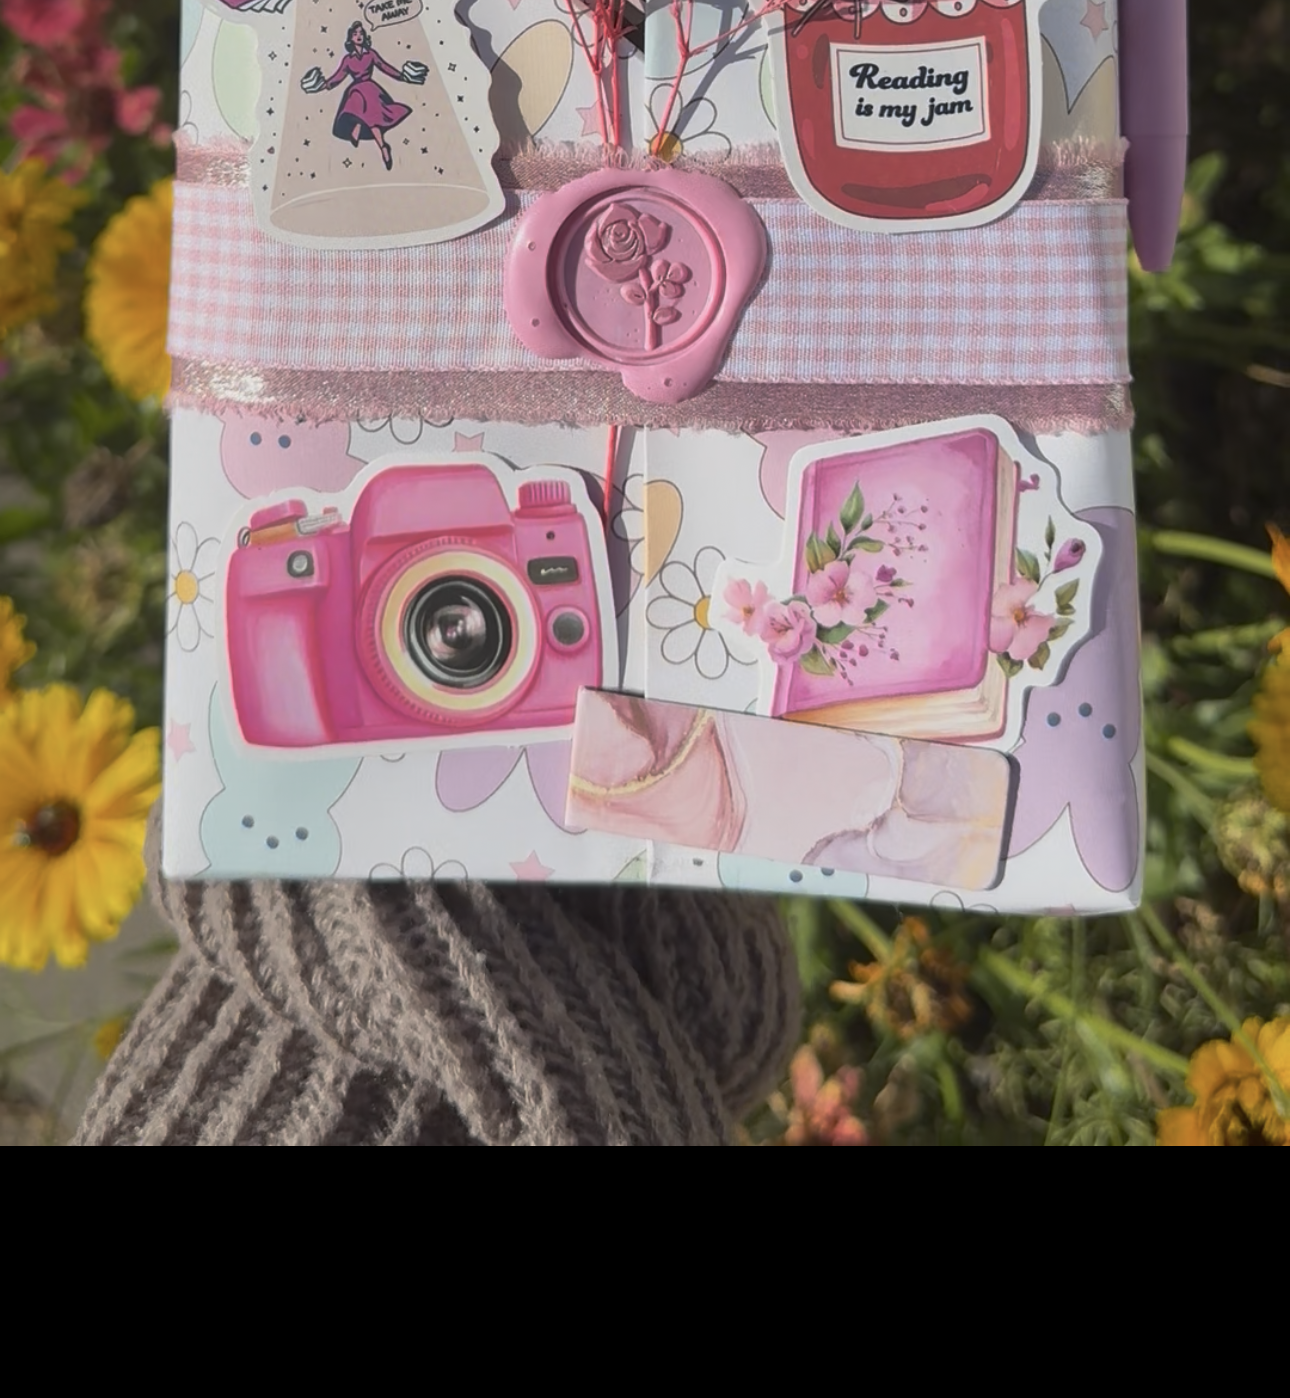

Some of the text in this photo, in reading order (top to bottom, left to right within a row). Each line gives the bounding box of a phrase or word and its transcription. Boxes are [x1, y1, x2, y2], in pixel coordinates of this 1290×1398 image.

[368, 0, 395, 14] TAKE
[381, 7, 409, 21] AWAY
[849, 63, 969, 95] Reading
[855, 97, 973, 127] is my jam
